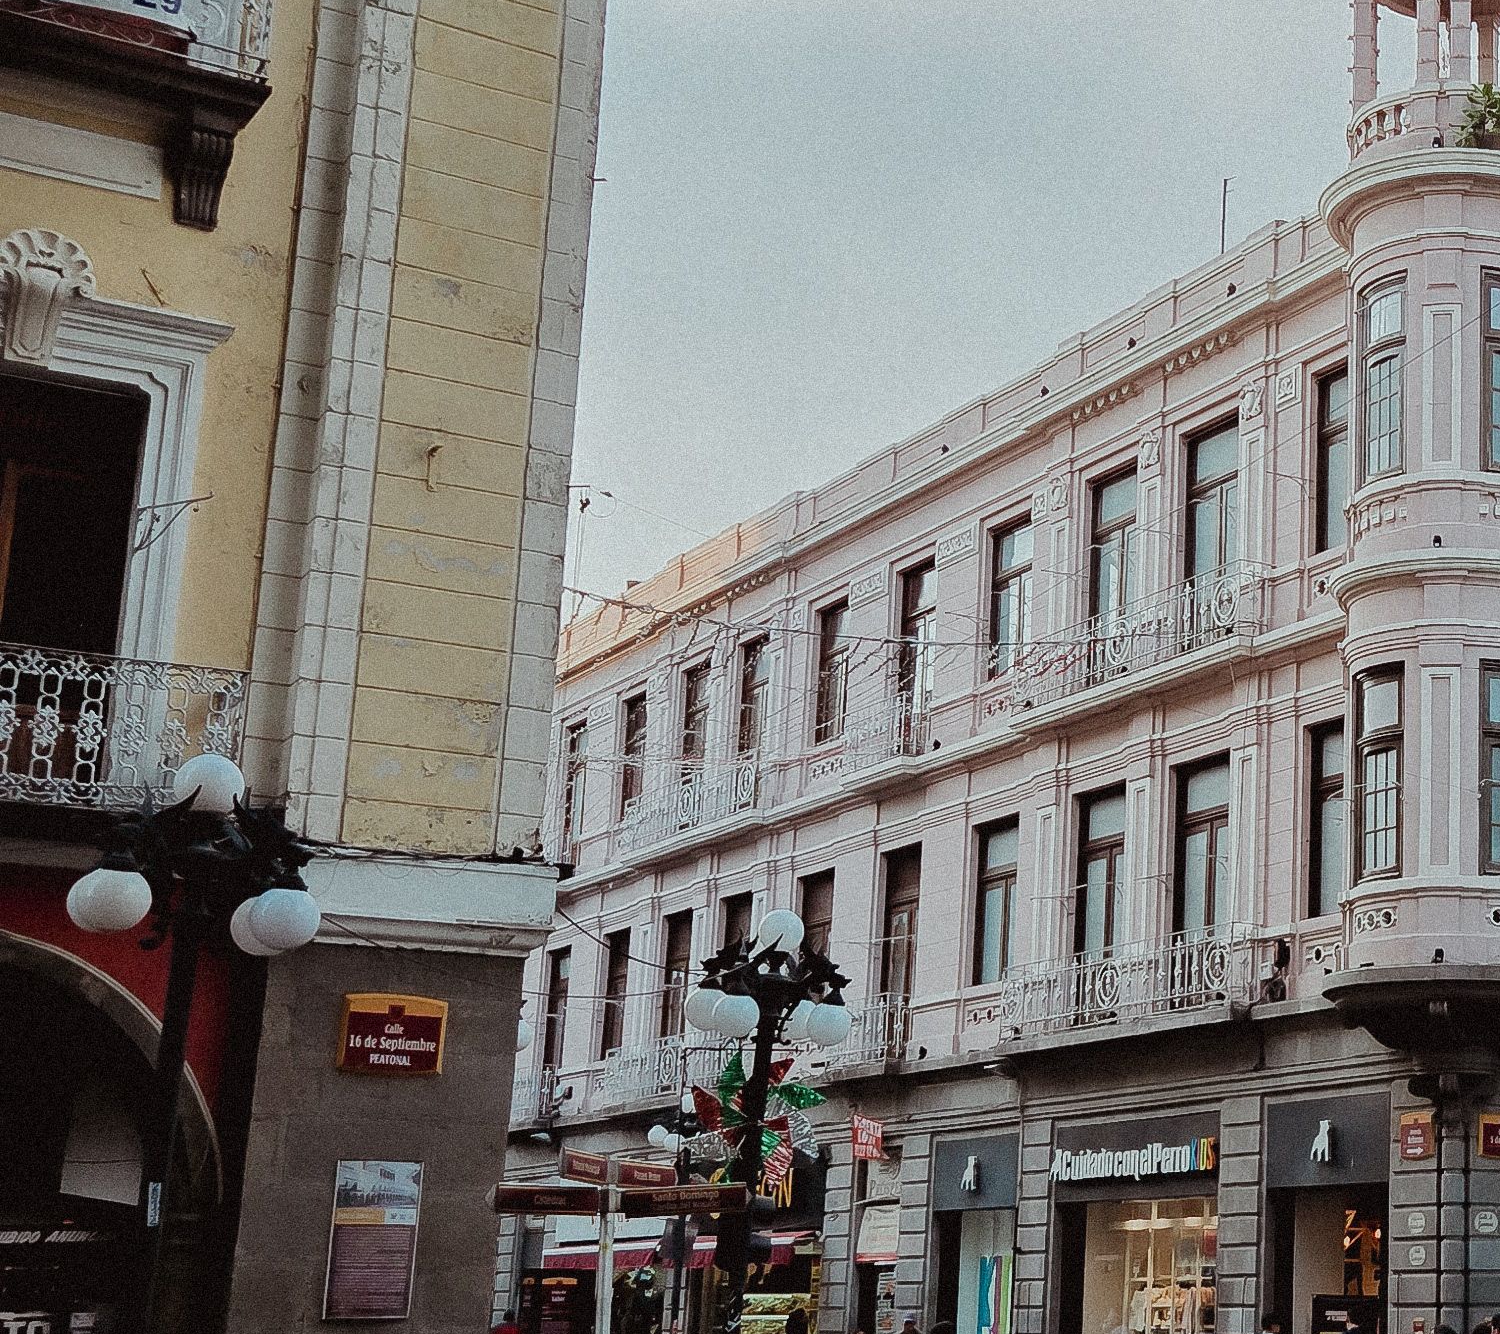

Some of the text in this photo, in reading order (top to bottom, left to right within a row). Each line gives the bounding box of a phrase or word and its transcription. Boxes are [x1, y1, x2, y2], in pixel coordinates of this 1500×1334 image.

[384, 1023, 405, 1035] Calle
[349, 1034, 437, 1052] 16 de Septiembre
[369, 1053, 412, 1066] PEATONAL
